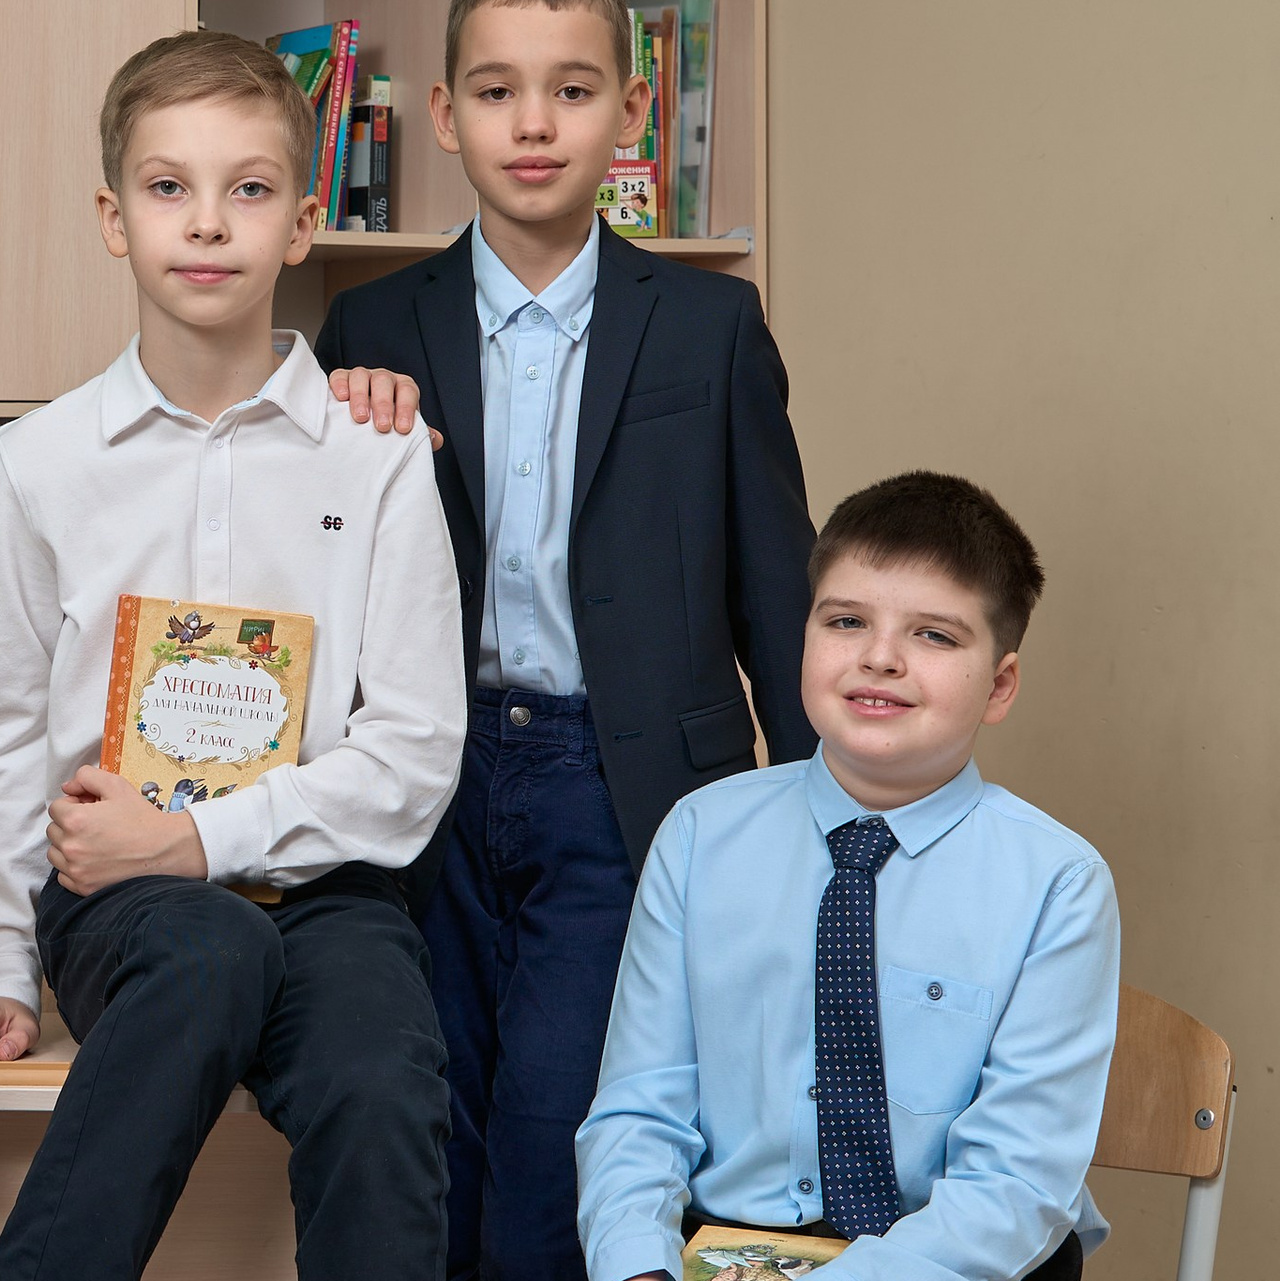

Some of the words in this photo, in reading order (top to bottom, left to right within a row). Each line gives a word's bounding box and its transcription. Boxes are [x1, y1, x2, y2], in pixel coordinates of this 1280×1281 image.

[334, 60, 345, 100] СКАЗКИ
[329, 102, 341, 147] ПУШКИНА
[607, 189, 614, 201] 3
[622, 181, 628, 193] 3
[638, 181, 645, 192] 2
[162, 675, 272, 705] ХРЕСТОМАТИЯ
[152, 698, 170, 708] ДЛЯ
[173, 700, 237, 718] НАЧАЛЬНОЙ
[239, 709, 279, 723] ШКОЛЫ
[186, 728, 196, 743] 2
[200, 733, 236, 749] КЛАСС
